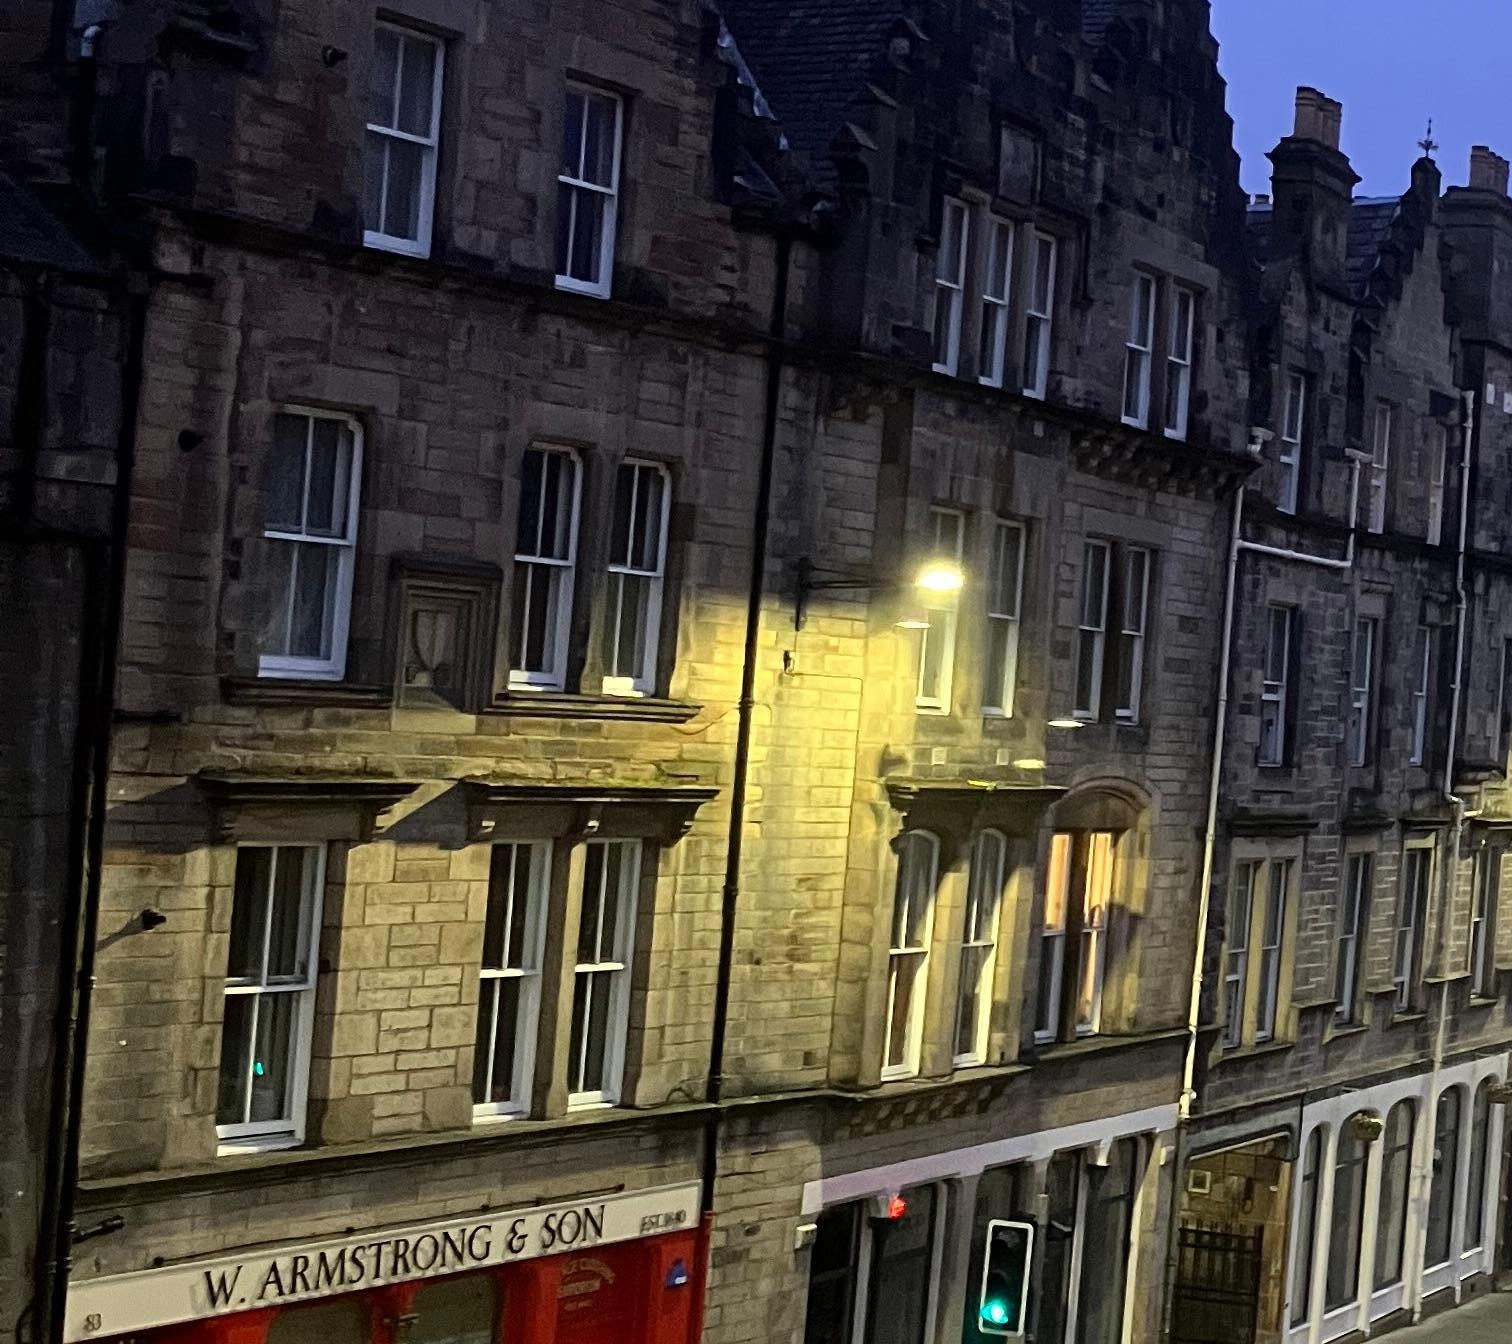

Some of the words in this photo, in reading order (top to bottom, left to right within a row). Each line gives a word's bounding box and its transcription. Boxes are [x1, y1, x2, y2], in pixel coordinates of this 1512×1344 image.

[203, 1265, 247, 1309] W.
[257, 1224, 493, 1300] ARMSTRONG
[507, 1218, 529, 1255] &
[540, 1204, 606, 1249] SON
